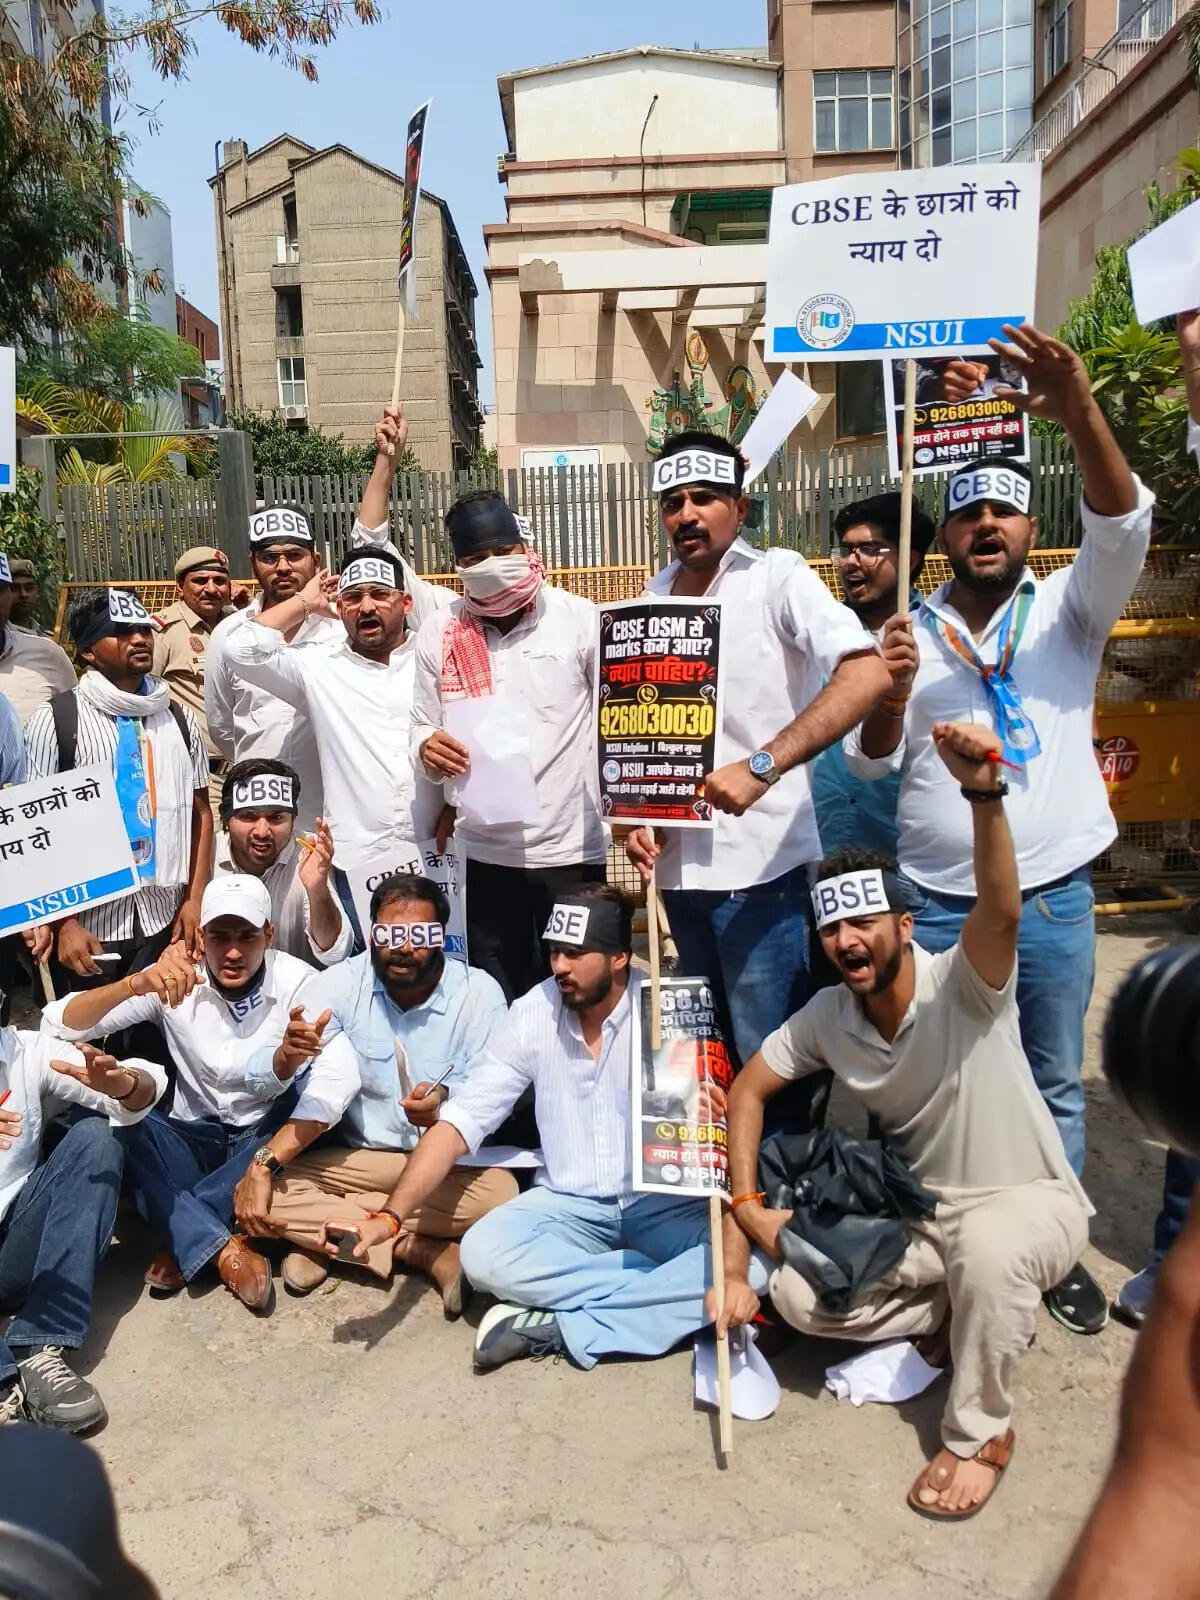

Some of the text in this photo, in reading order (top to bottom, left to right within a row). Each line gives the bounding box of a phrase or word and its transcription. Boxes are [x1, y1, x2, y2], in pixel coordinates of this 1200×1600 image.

[791, 180, 1021, 225] CBSE के छात्रों को
[848, 229, 942, 263] न्याय दो
[884, 320, 966, 348] NSUI
[936, 441, 979, 458] NSUI
[657, 454, 730, 485] CBSE
[952, 473, 1027, 506] CBSE
[253, 512, 308, 536] CBSE
[339, 561, 393, 588] CBSE
[110, 594, 148, 619] CBS
[612, 616, 705, 641] CBSE OSM से
[605, 637, 713, 659] marks कम आए?
[608, 656, 707, 682] न्याय चाहिए?
[600, 703, 714, 736] 9268030030
[622, 762, 644, 778] NSUI
[18, 786, 68, 819] छात्रों
[72, 778, 101, 802] को
[235, 778, 291, 803] CBSE
[28, 826, 51, 850] दो
[425, 851, 443, 868] के
[24, 883, 91, 920] NSUI
[372, 923, 443, 947] CBSE
[683, 1166, 726, 1182] NSUI
